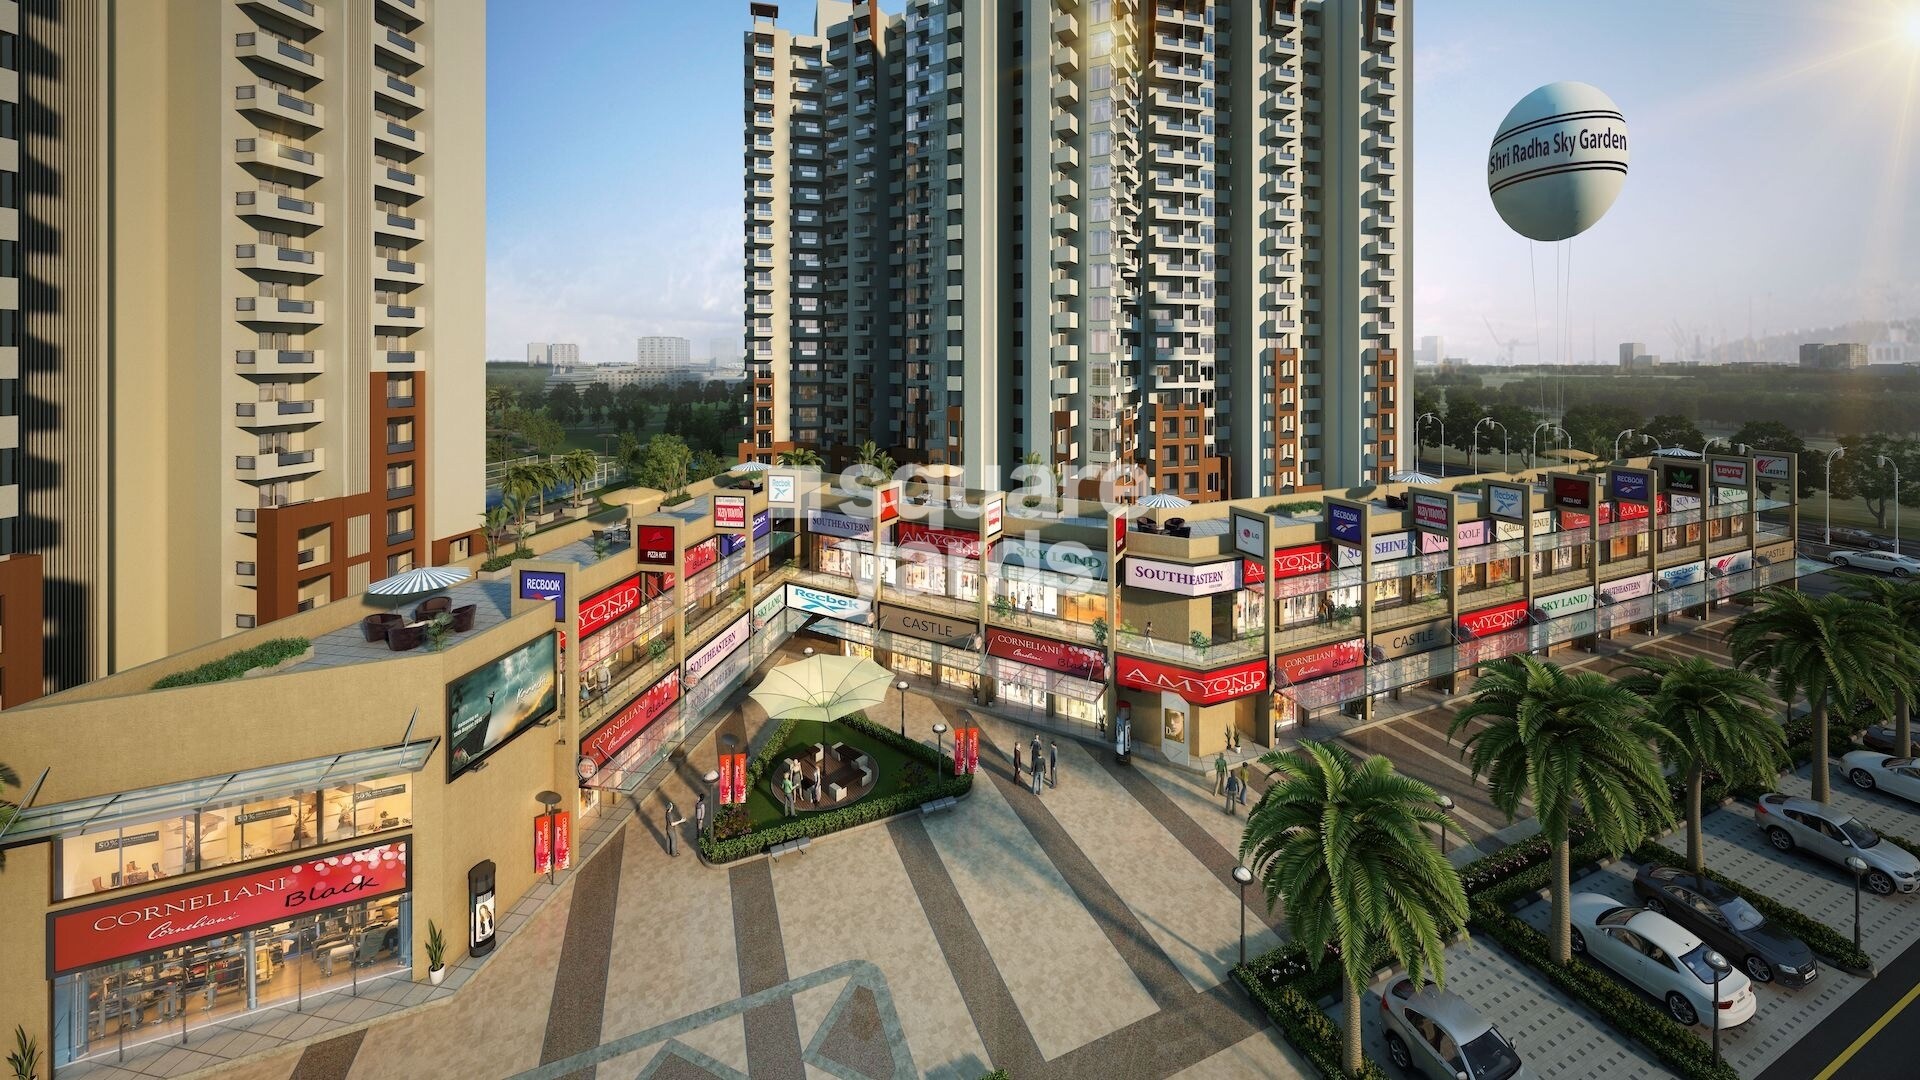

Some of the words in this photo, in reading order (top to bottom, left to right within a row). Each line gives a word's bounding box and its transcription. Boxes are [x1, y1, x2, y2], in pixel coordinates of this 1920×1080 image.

[1490, 147, 1510, 175] Shri
[1513, 137, 1550, 165] Radha
[1553, 130, 1576, 157] Sky
[1579, 127, 1627, 151] Garden
[812, 517, 870, 533] SOUTHEASTERN
[956, 547, 981, 555] SHO
[1016, 545, 1049, 560] SKY
[1052, 552, 1102, 568] LAND
[1374, 538, 1408, 555] SHINE
[527, 578, 561, 592] RECBOOK
[1135, 566, 1224, 586] SOUTHEASTERN
[603, 600, 634, 622] SHOP
[1542, 600, 1560, 612] SKY
[1561, 593, 1588, 608] LAND
[902, 616, 953, 638] CASTLE
[997, 634, 1059, 655] CORNELIANI
[1393, 629, 1435, 649] CASTLE
[689, 631, 737, 674] SOUTHEASTERN
[1285, 650, 1336, 669] CORNELIANI
[1125, 668, 1266, 695] AMYOND
[1228, 682, 1261, 696] SHOP
[592, 697, 649, 750] CORNELIANI
[284, 875, 380, 908] Black
[93, 877, 286, 932] CORNELIANI
